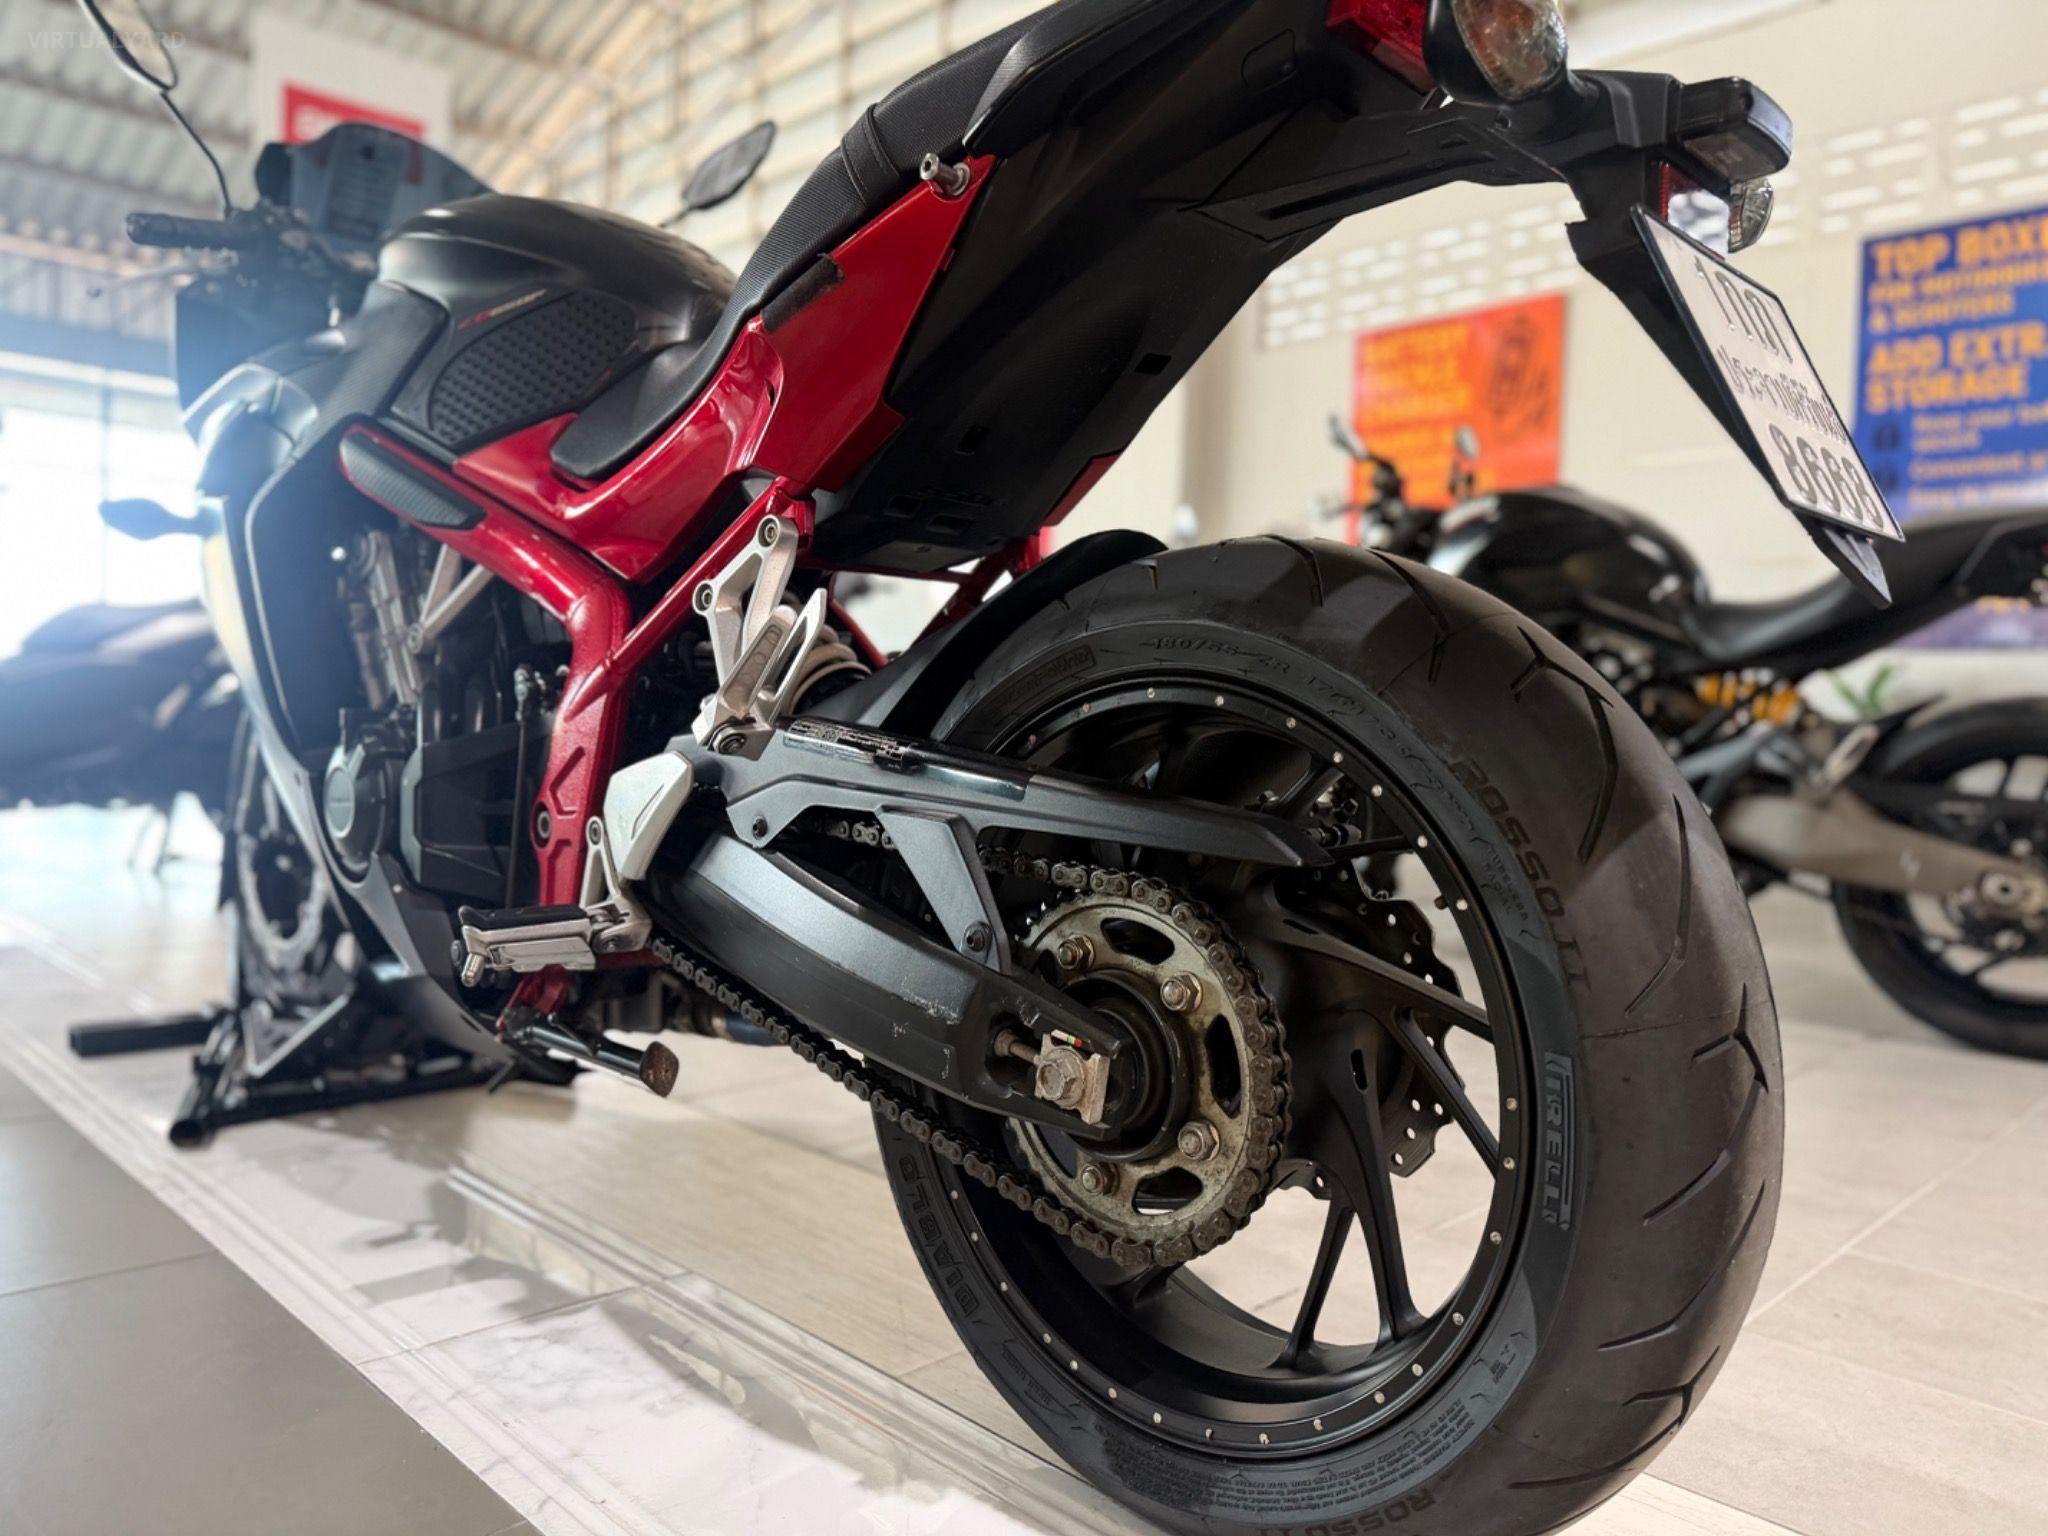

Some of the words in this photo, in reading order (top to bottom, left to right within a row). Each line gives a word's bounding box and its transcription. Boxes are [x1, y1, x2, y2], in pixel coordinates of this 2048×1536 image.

[1874, 233, 1950, 278] TOP
[1949, 320, 2048, 368] EXTR
[1768, 422, 1884, 532] 8668
[1451, 757, 1566, 917] ROSSO
[1541, 1051, 1575, 1231] PIRELLI
[898, 1152, 981, 1318] DIABLO
